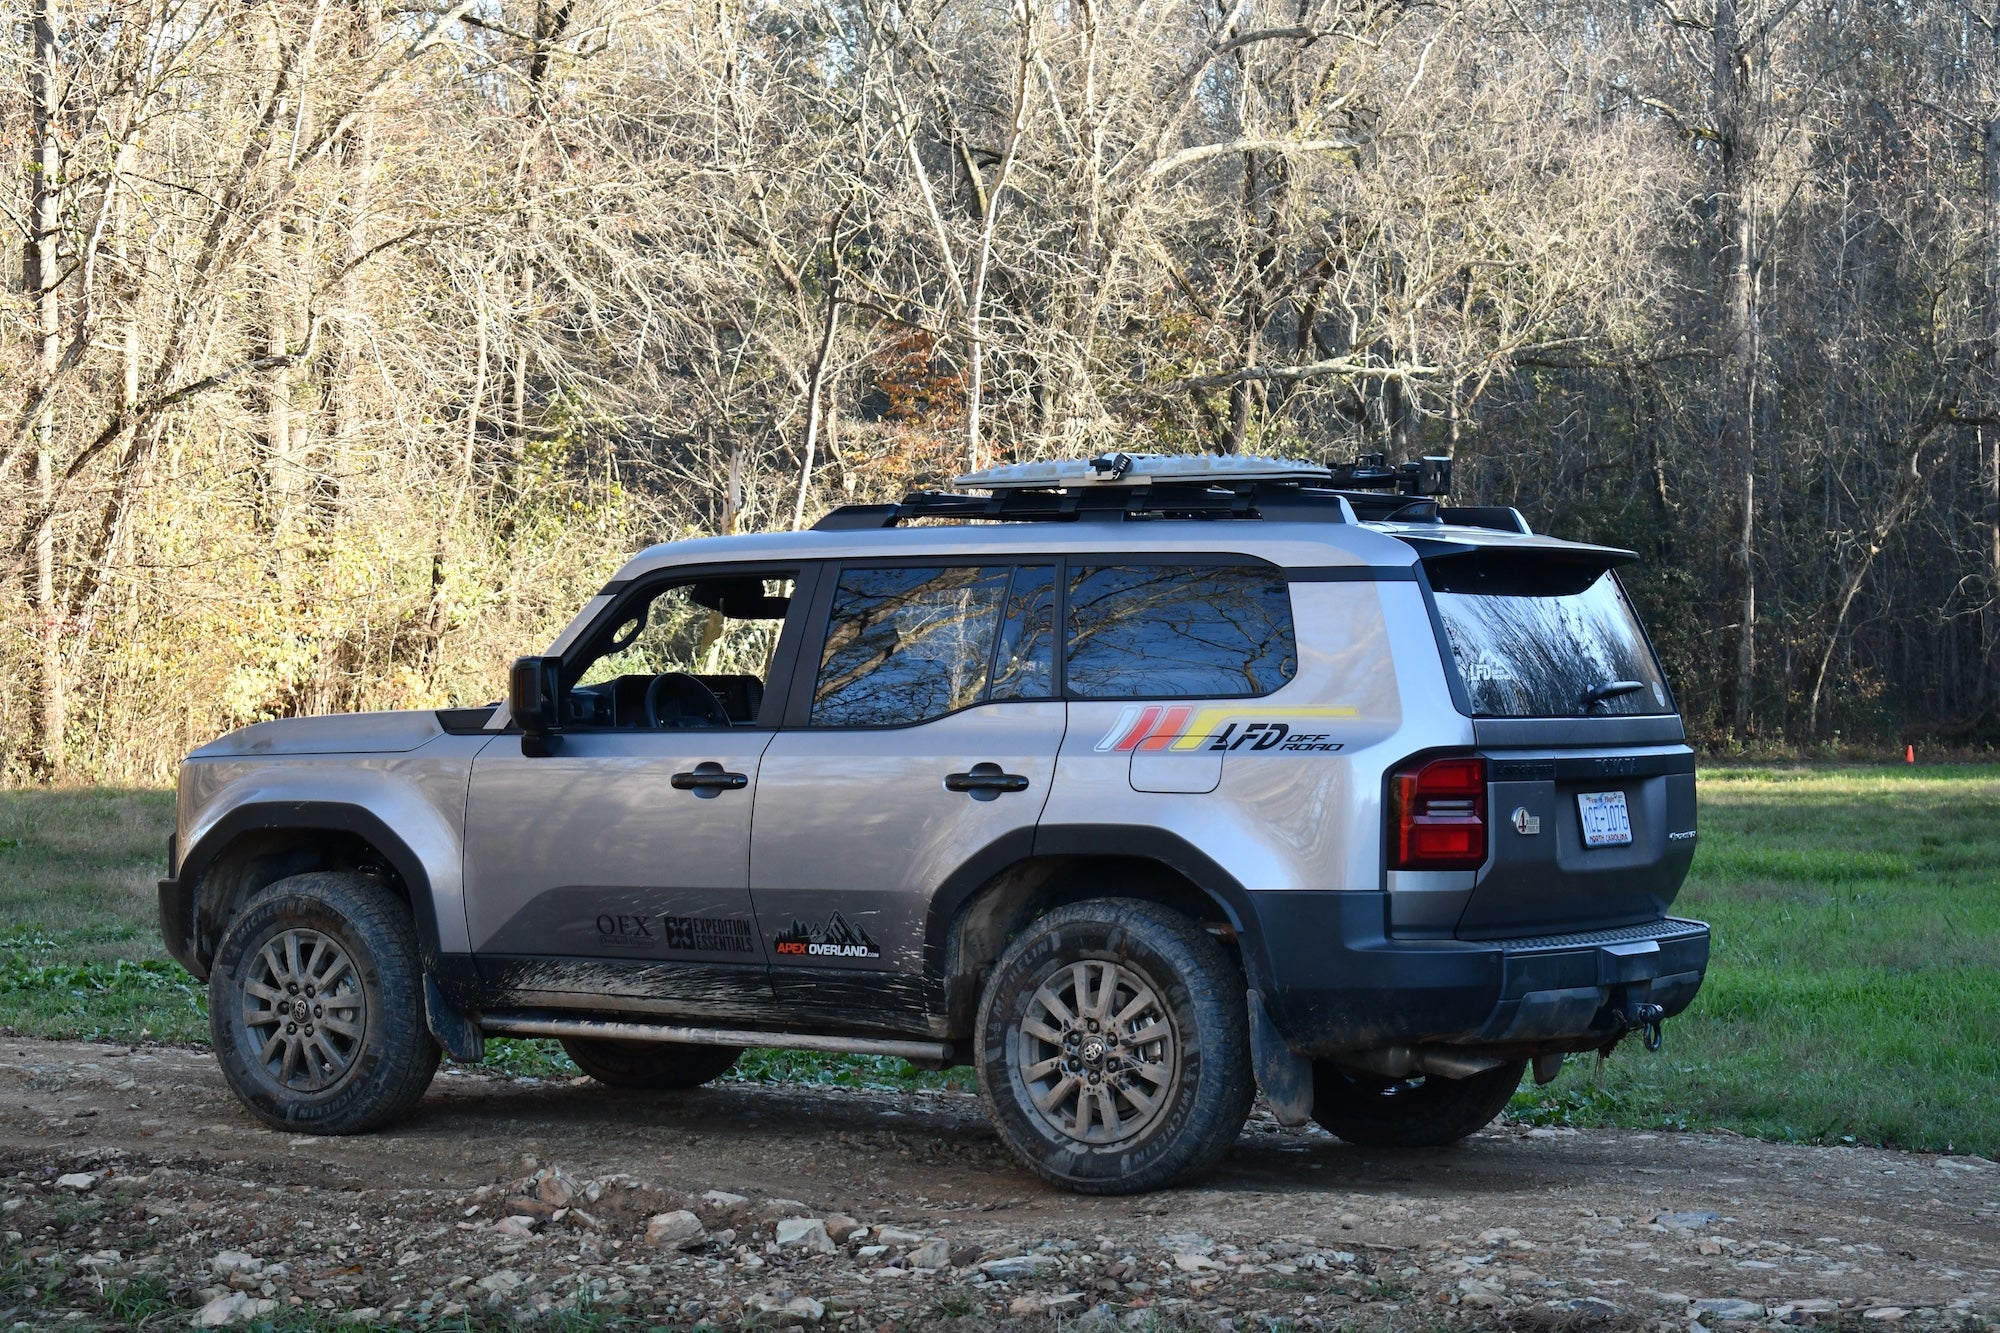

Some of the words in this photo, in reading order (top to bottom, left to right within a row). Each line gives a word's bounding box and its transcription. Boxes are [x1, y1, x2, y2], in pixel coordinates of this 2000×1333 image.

[1208, 723, 1290, 751] LFD
[1286, 734, 1330, 742] OFF
[1279, 743, 1345, 751] ROAD
[1518, 810, 1527, 832] 4
[1590, 834, 1604, 843] NORTH
[1605, 833, 1628, 842] CAROLINA
[596, 914, 653, 936] OEX
[693, 917, 751, 935] EXPEDITION
[696, 935, 754, 953] ESSENTIALS
[777, 942, 806, 954] APEX
[1134, 1087, 1193, 1165] MICHELIN
